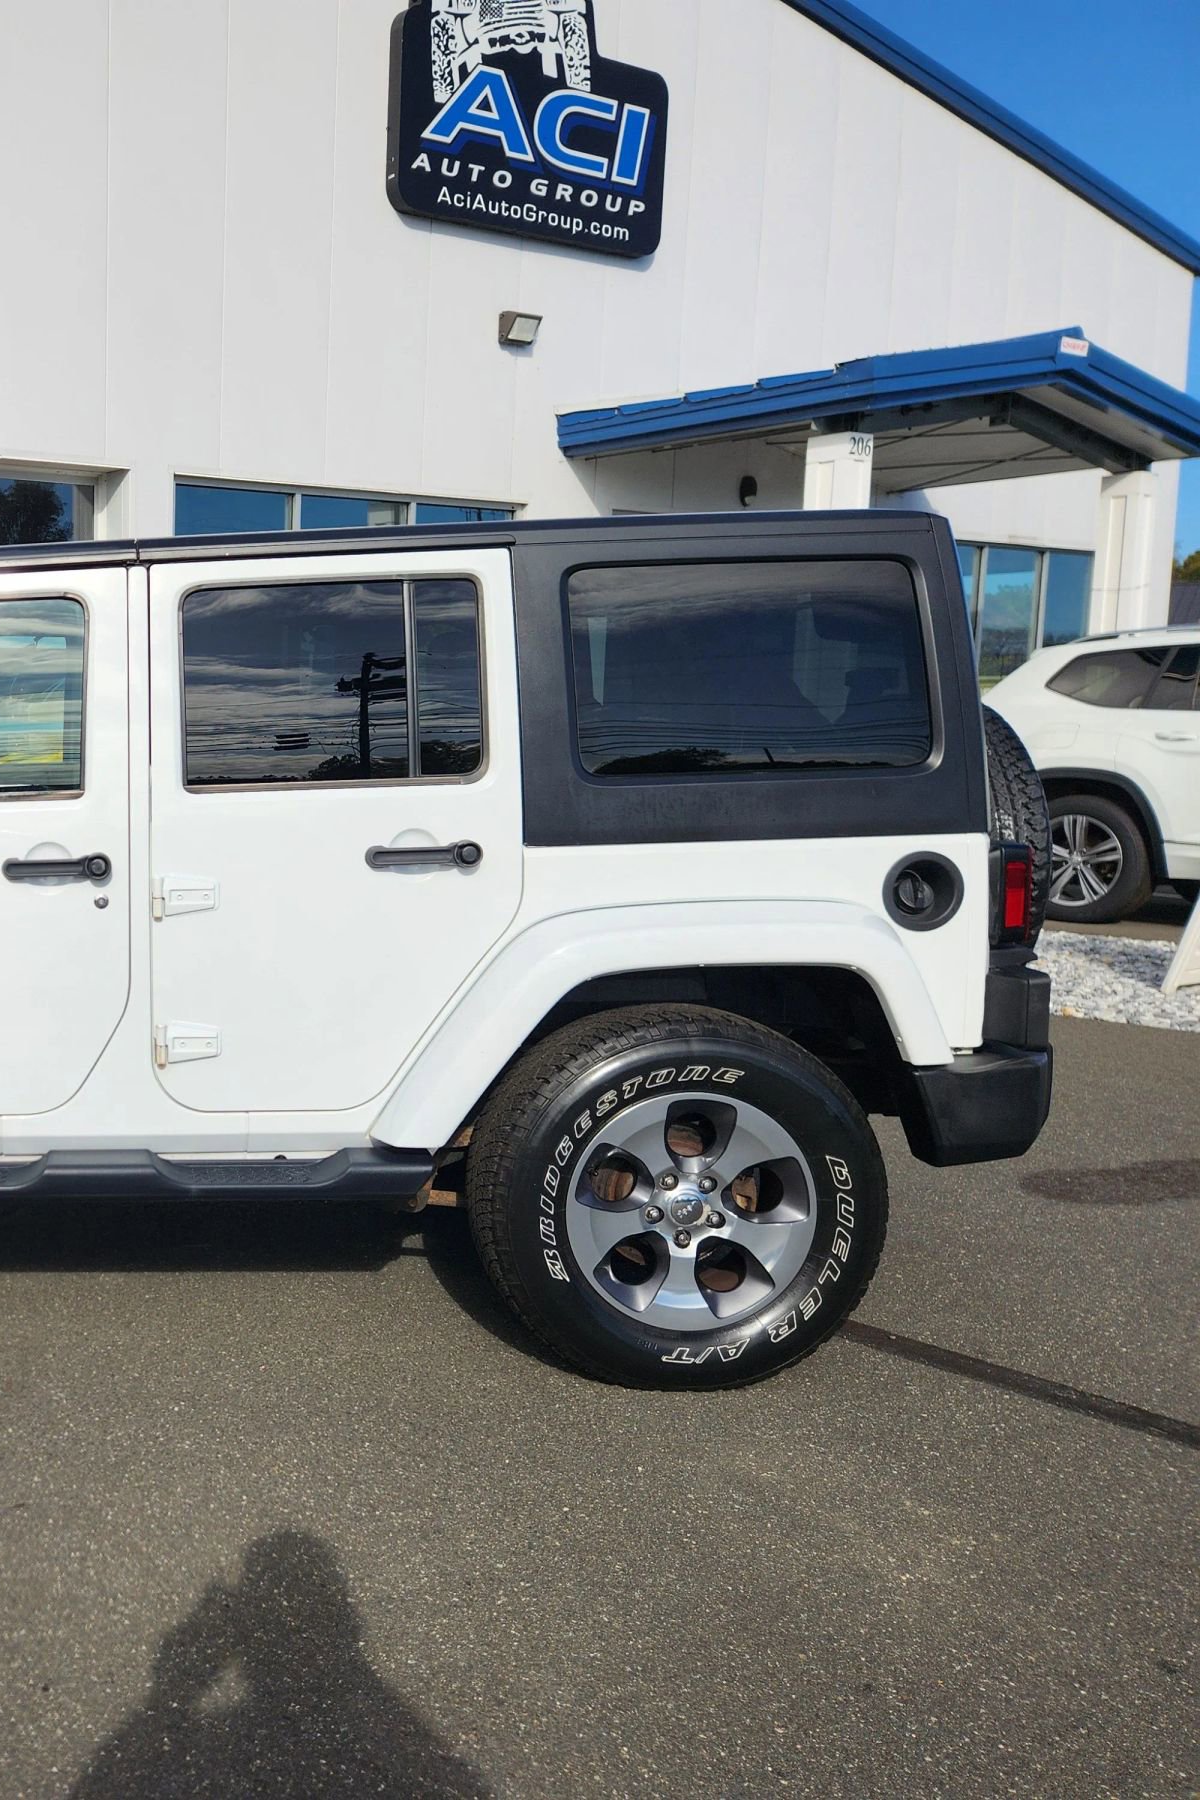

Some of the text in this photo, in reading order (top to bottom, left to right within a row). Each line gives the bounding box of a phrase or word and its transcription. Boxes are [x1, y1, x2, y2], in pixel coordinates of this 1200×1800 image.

[421, 64, 650, 187] ACI
[411, 152, 647, 217] AUTO GROUP
[437, 186, 630, 242] AciAutoGroup.com
[849, 436, 872, 456] 206
[539, 1065, 745, 1283] BRIDGESTONE
[662, 1154, 855, 1365] DUELER A/T
